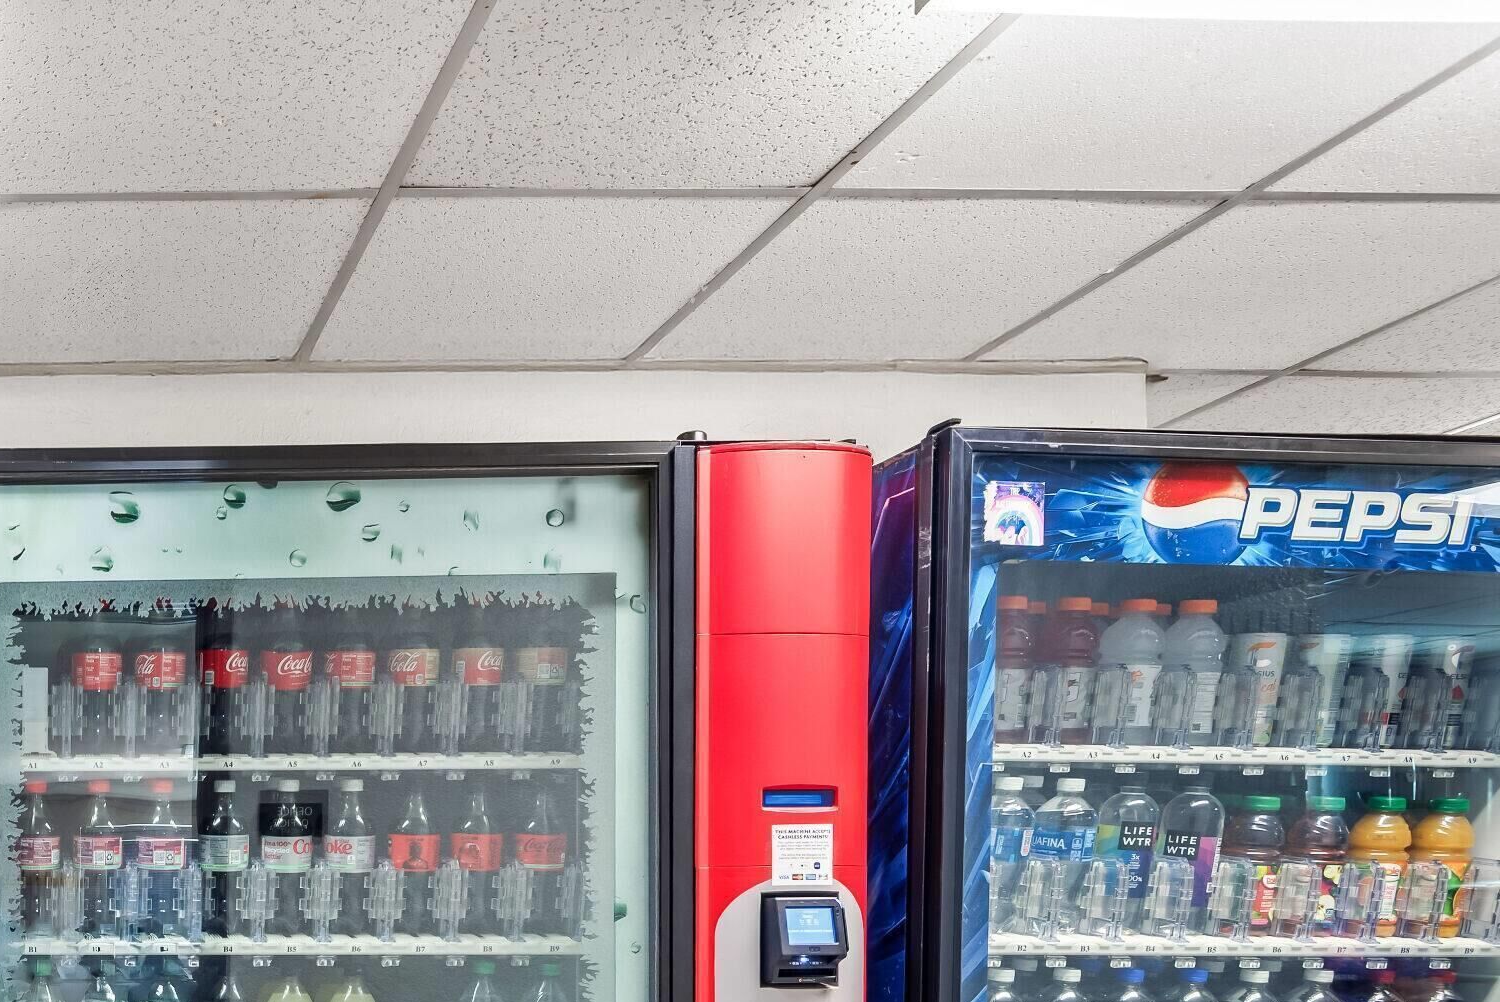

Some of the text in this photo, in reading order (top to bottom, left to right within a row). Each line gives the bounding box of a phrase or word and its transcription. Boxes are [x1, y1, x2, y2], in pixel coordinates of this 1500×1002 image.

[1240, 487, 1477, 547] PEPSI
[1124, 826, 1153, 836] LIFE
[1123, 837, 1152, 847] WTR
[1168, 834, 1198, 845] LIFE
[325, 838, 353, 856] oke
[1166, 845, 1196, 856] WTR
